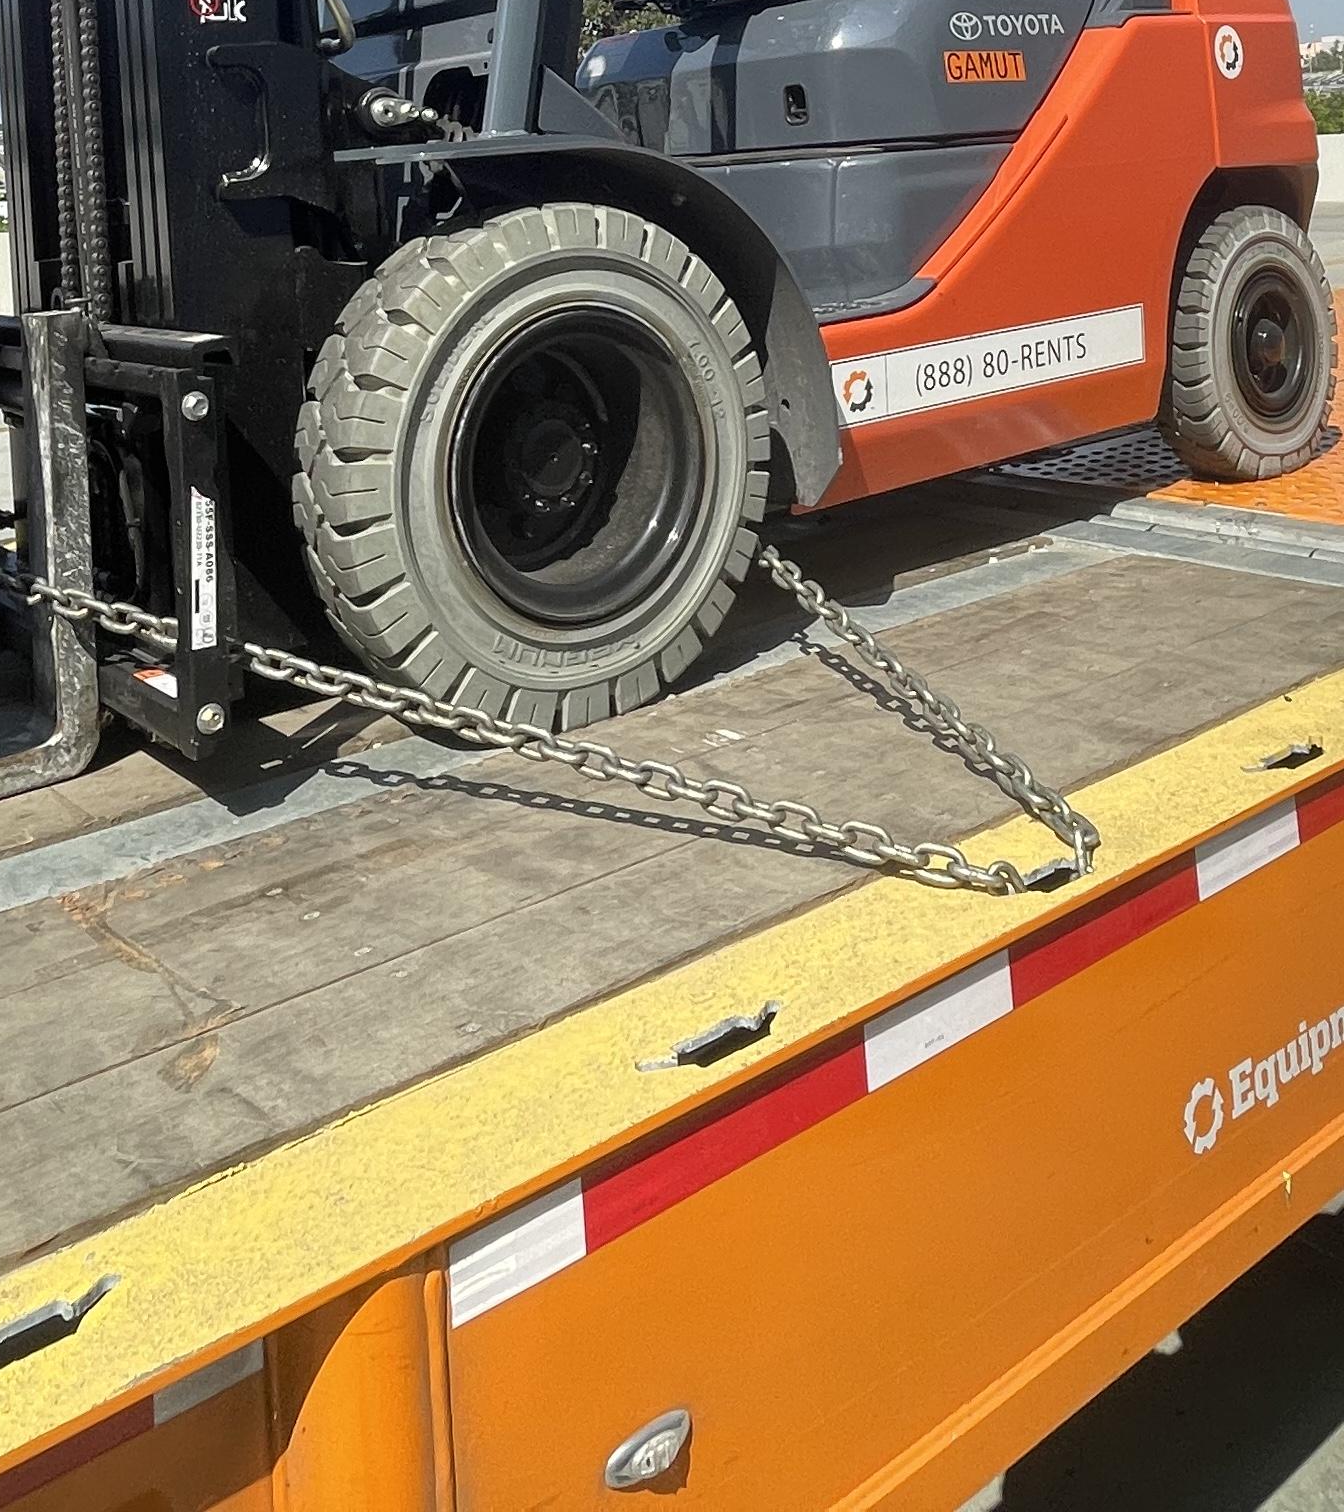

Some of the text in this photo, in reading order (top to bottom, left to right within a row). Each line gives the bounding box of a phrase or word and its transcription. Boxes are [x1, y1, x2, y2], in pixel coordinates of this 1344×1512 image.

[982, 13, 1065, 37] TOYOTA
[947, 52, 1021, 81] GAMUT
[915, 332, 1087, 398] (888) 80-RENTS
